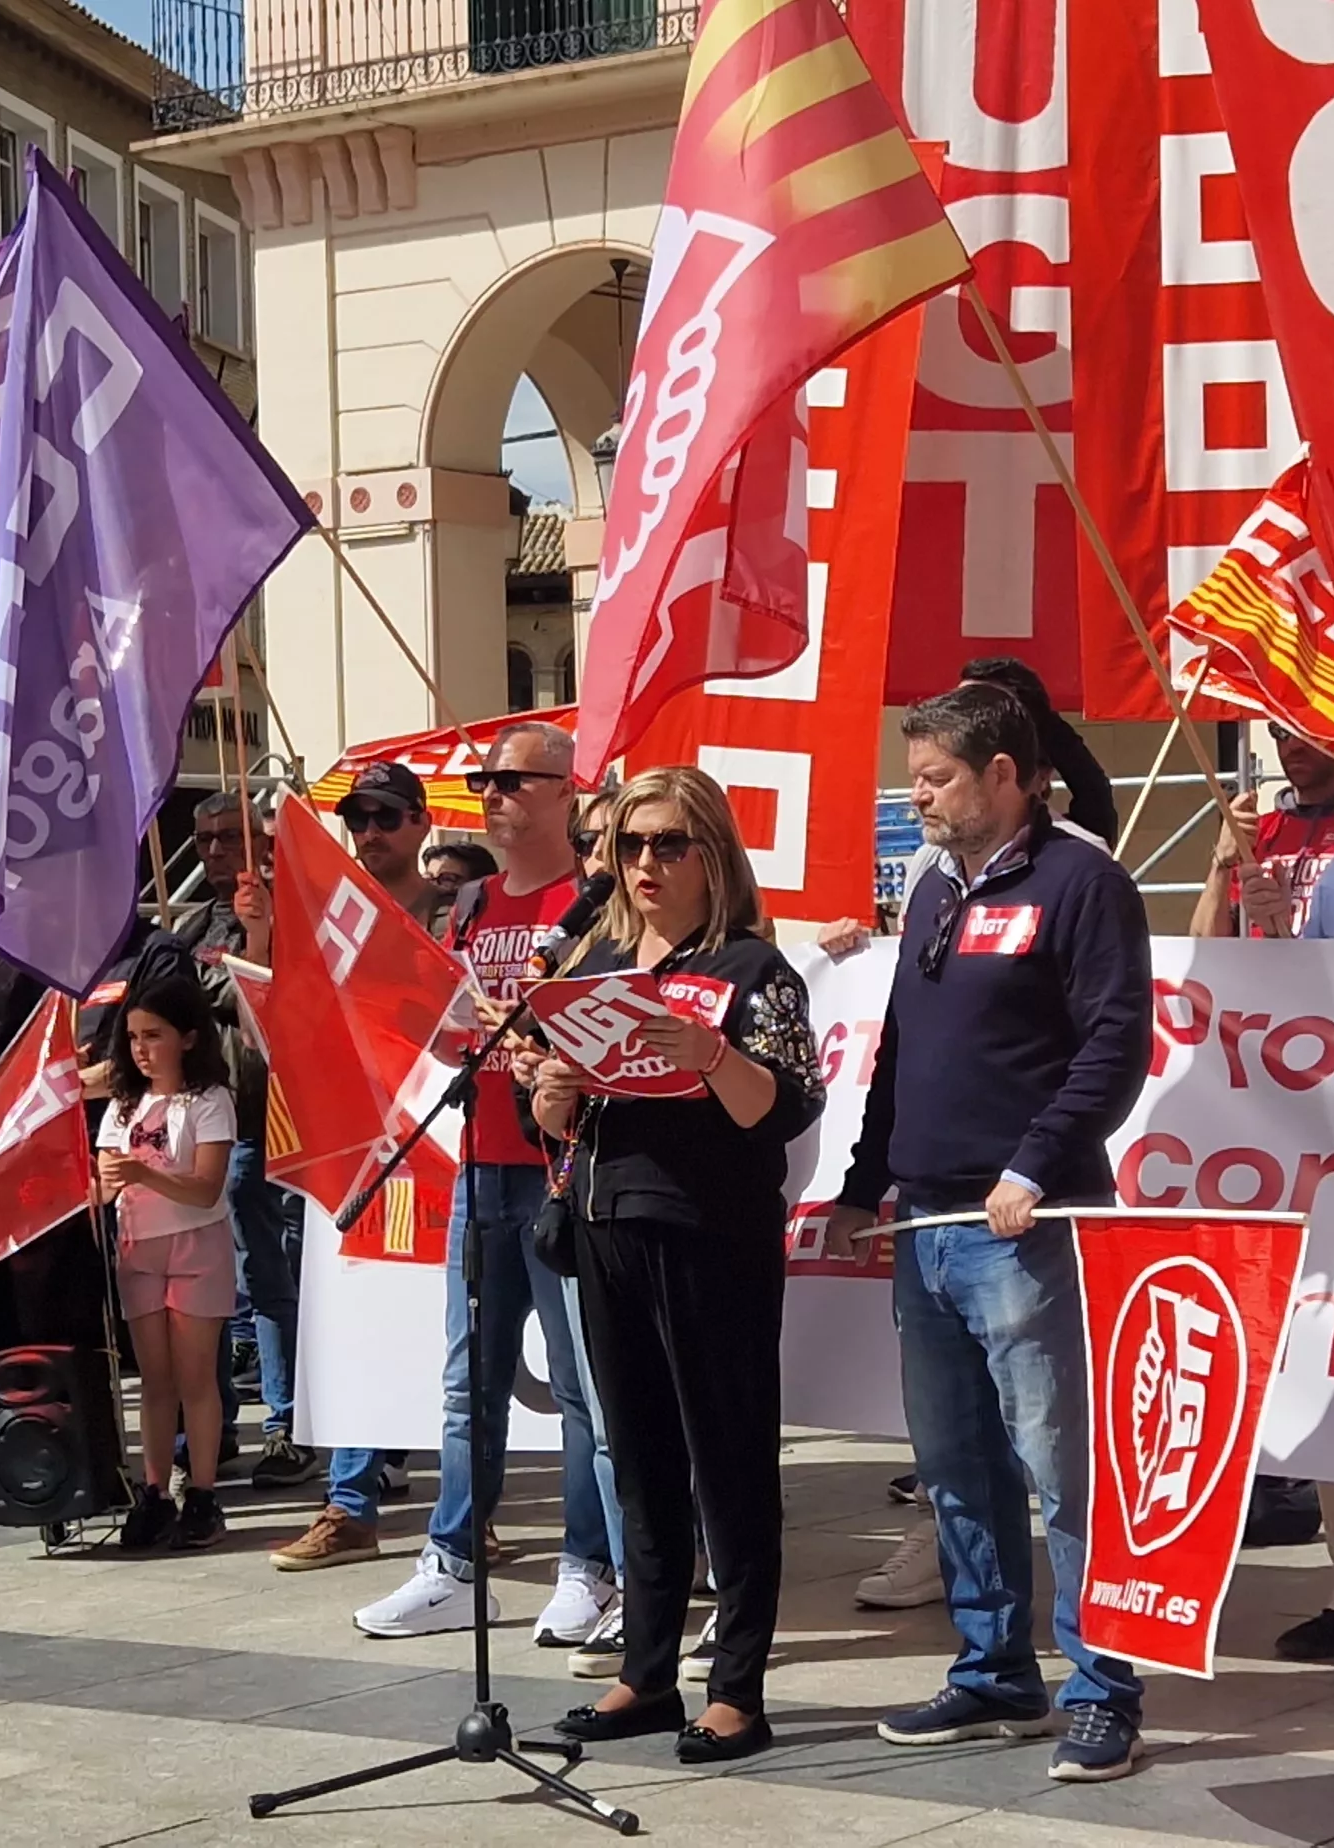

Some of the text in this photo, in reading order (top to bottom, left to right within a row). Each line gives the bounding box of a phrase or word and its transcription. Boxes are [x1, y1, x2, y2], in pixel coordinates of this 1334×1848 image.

[539, 977, 670, 1067] UGT
[819, 1020, 884, 1086] GT
[1149, 1295, 1219, 1510] UGT
[1090, 1578, 1200, 1625] www.UGT.es
